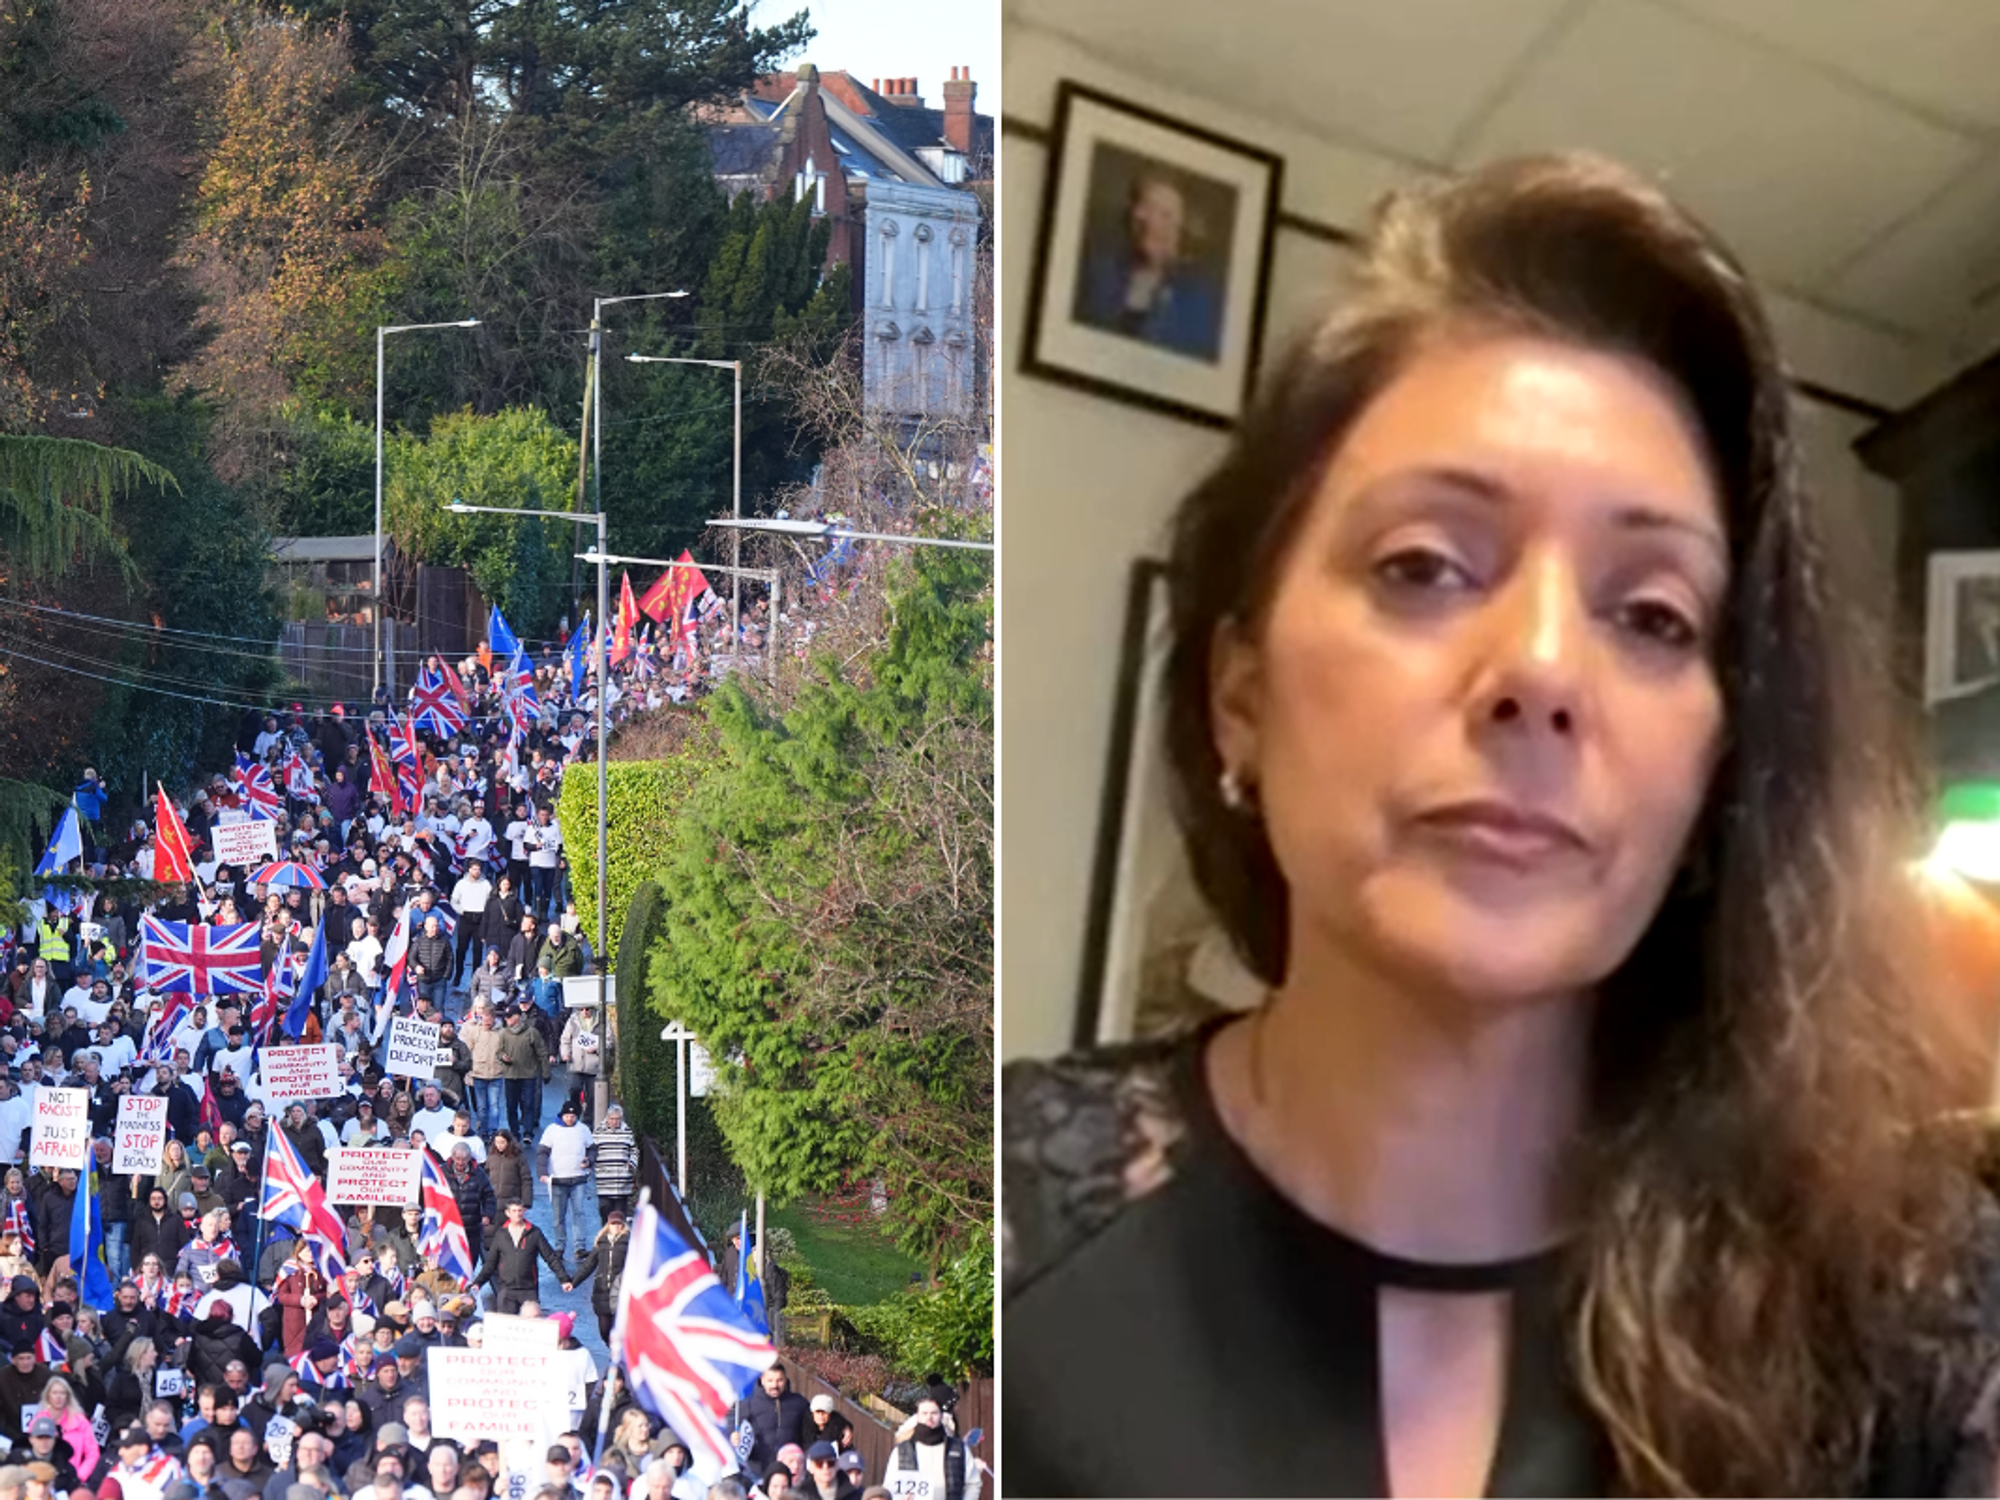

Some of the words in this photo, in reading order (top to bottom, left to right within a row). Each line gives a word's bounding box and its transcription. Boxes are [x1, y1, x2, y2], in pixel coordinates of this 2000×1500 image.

[395, 1021, 438, 1038] DETAIN
[393, 1034, 436, 1050] PROCESS
[267, 1046, 327, 1058] PROTECT
[390, 1049, 434, 1066] DEPORT
[269, 1072, 329, 1084] PROTECT
[48, 1091, 73, 1104] NOT
[271, 1087, 331, 1098] FAMILIES
[39, 1102, 82, 1117] RACIST
[125, 1098, 162, 1111] STOP
[42, 1125, 77, 1139] JUST
[120, 1121, 161, 1131] MADNESS
[122, 1134, 160, 1149] STOP
[33, 1141, 82, 1158] AFRAID
[341, 1151, 411, 1160] PROTECT
[122, 1155, 157, 1169] BOATS
[339, 1164, 409, 1173] COMMUNITY
[337, 1178, 409, 1188] PROTECT
[336, 1193, 407, 1203] FAMILIES
[445, 1354, 549, 1367] PROTECT
[446, 1377, 548, 1387] COMMUNITY
[447, 1398, 540, 1410] PROTEC
[449, 1420, 537, 1433] FAMILIE
[894, 1480, 930, 1497] 128
